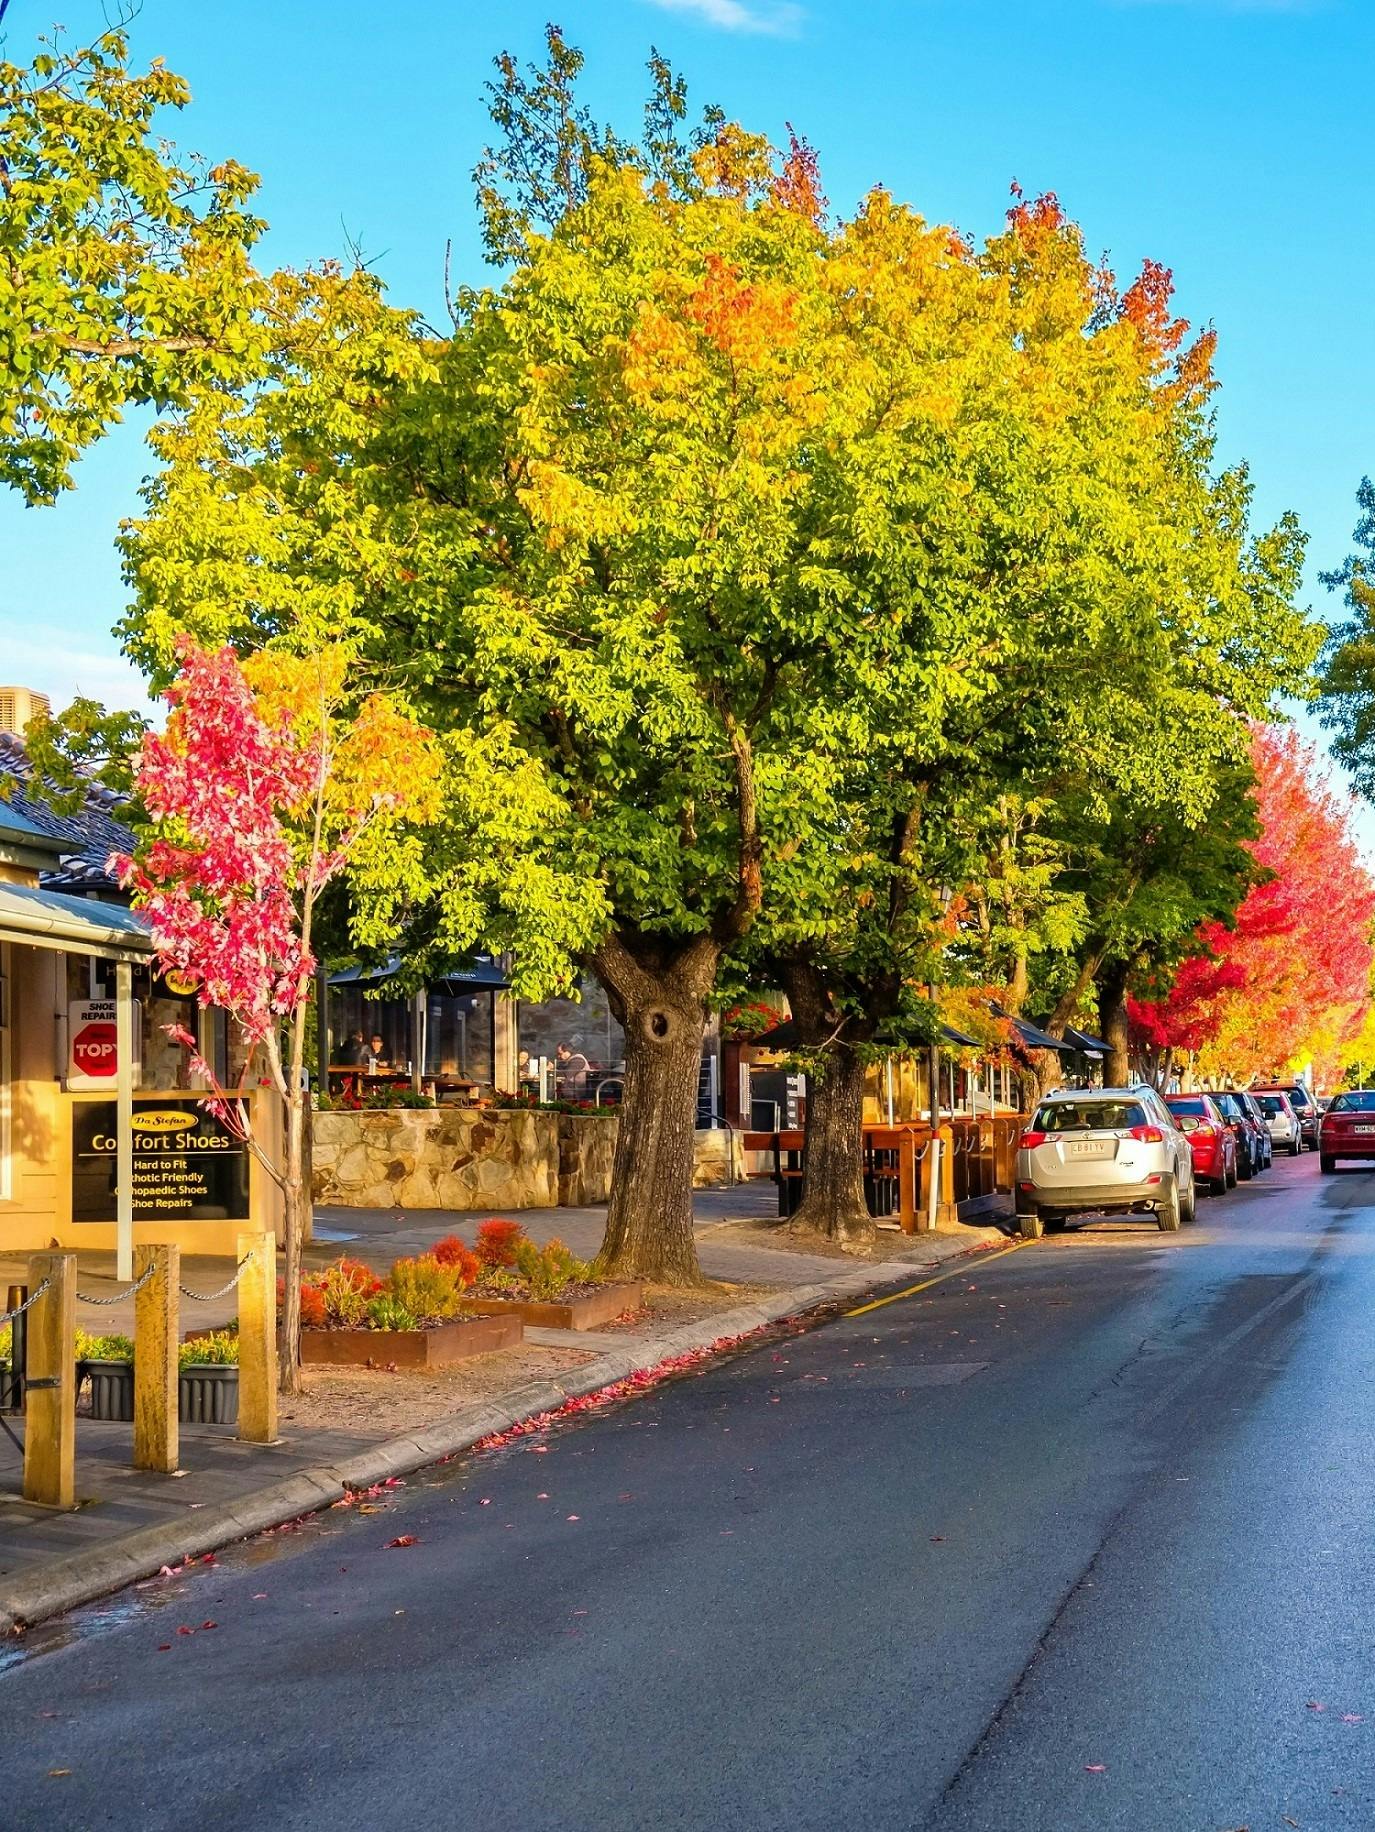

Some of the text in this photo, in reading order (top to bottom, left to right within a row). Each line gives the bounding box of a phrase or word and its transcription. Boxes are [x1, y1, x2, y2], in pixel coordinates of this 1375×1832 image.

[89, 1003, 115, 1011] SHOE
[81, 1012, 117, 1020] REPAIR
[76, 1043, 117, 1057] TOP
[152, 1116, 187, 1126] Stefan
[92, 1133, 229, 1150] Cofort Shoes
[134, 1160, 187, 1170] Hard to Fit
[131, 1173, 204, 1183] thotic Friendly
[114, 1185, 208, 1196] Ohopaedic Shoes
[131, 1199, 193, 1209] Shoe Repairs
